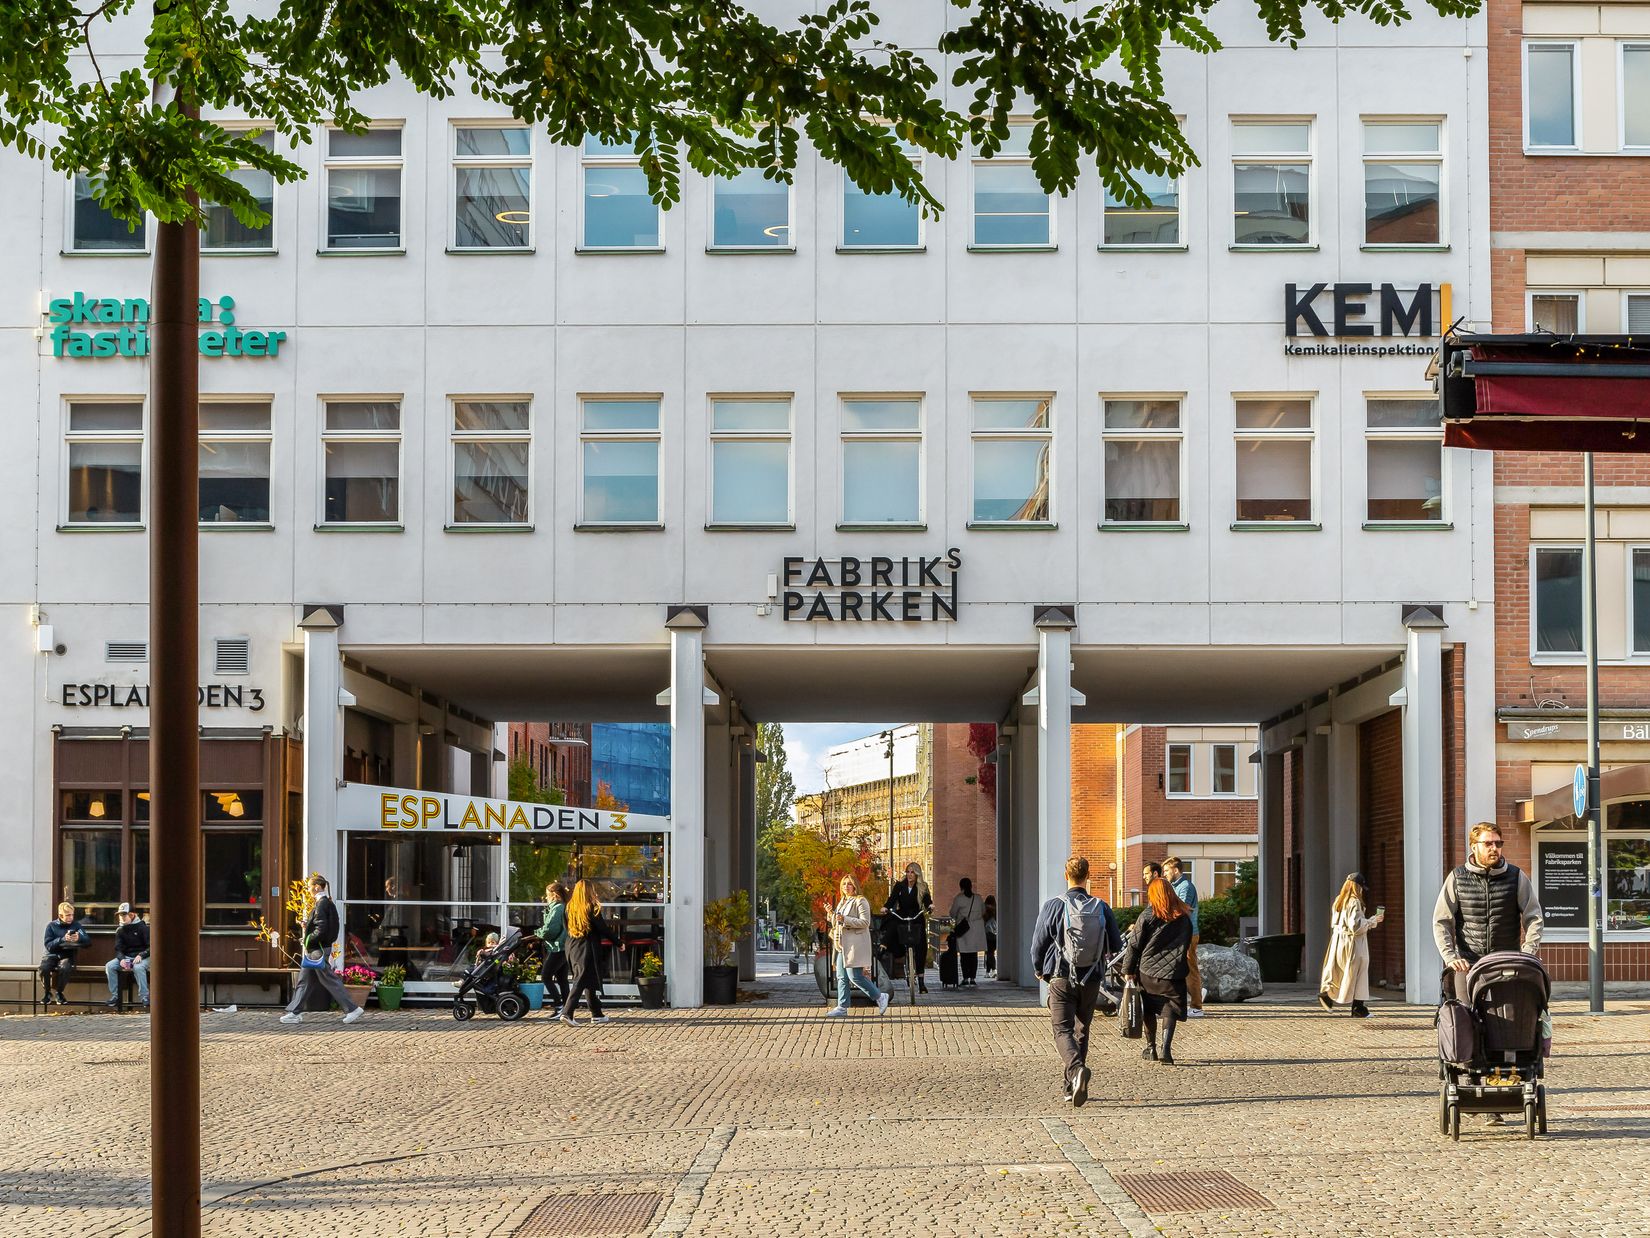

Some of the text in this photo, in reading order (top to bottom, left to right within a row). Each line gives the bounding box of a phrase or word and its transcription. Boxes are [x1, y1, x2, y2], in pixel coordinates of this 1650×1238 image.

[49, 292, 235, 325] skana:
[1285, 283, 1452, 337] KEMI
[50, 326, 286, 357] fastieter
[783, 571, 958, 621] PARKEN
[62, 684, 265, 711] ESPLAEN 3
[1523, 724, 1559, 739] Spendrups
[380, 793, 628, 830] ESPLANADEN 3
